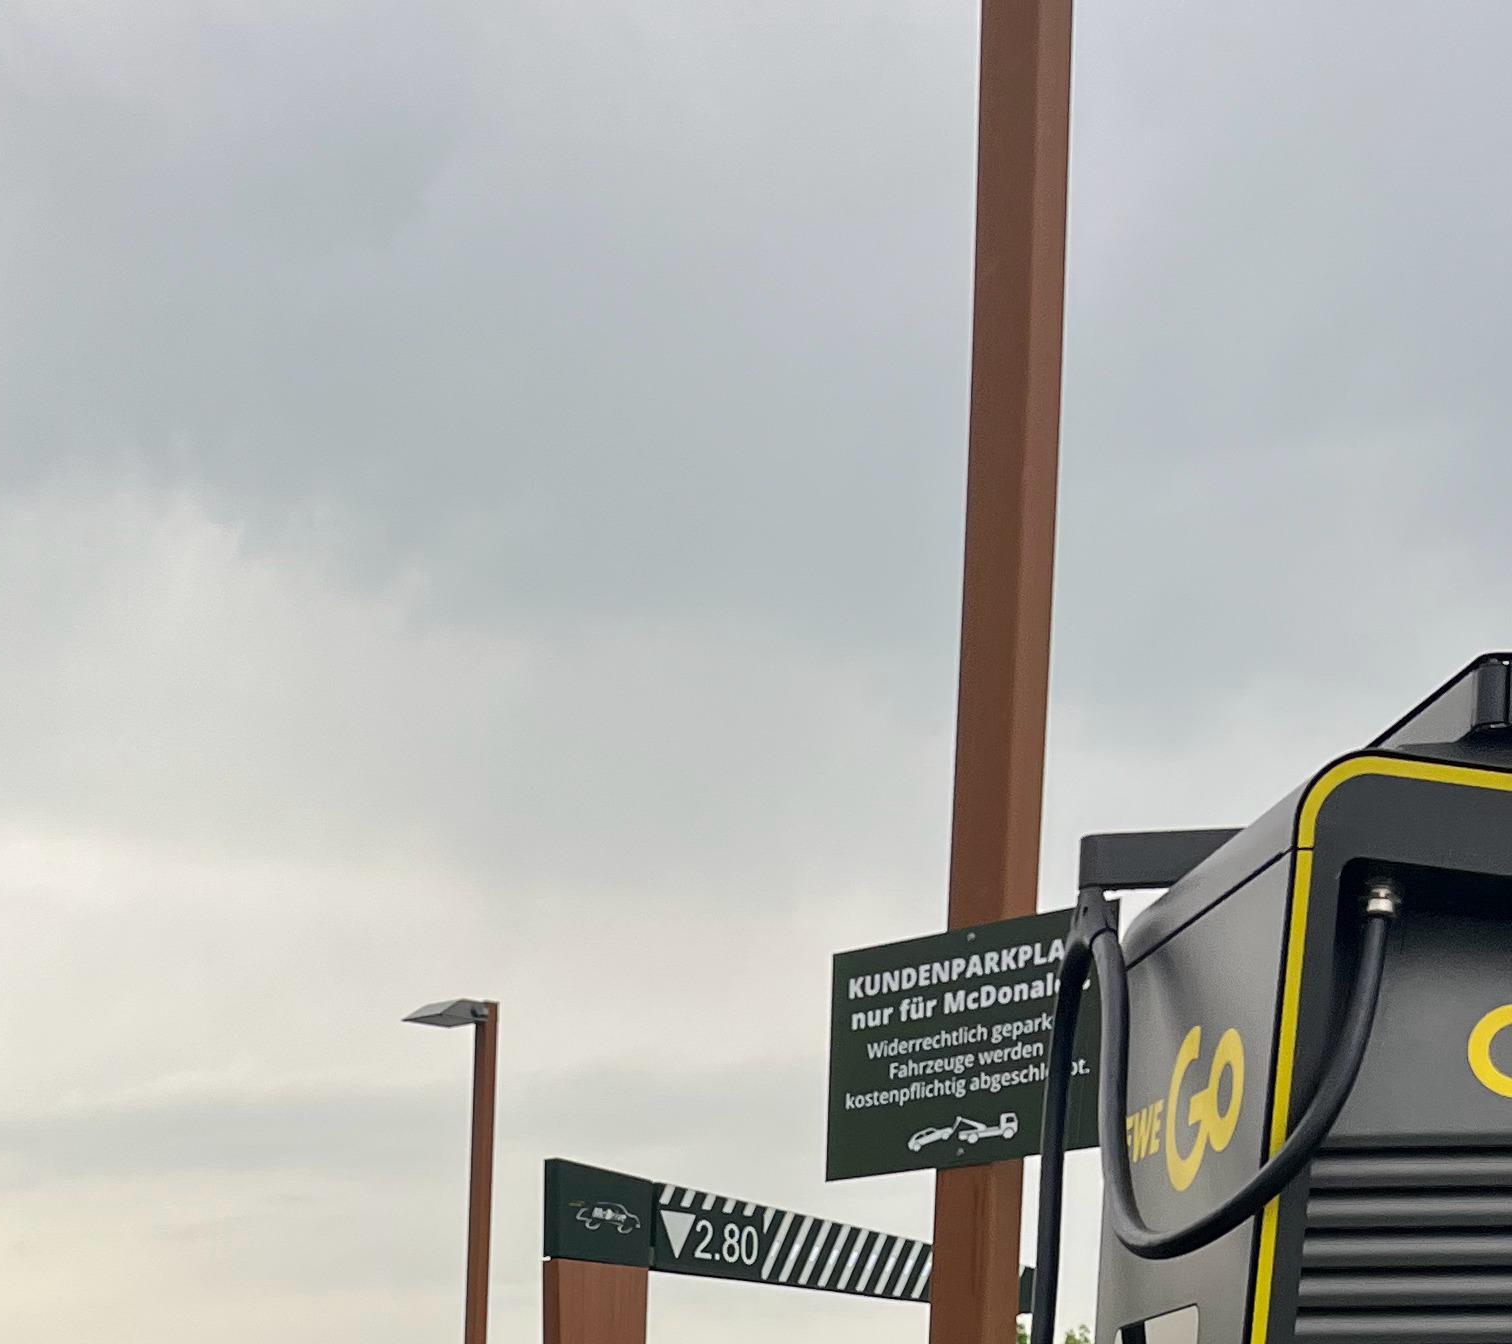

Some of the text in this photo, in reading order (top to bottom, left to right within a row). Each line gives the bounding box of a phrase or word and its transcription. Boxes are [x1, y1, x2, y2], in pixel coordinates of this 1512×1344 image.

[848, 938, 1066, 999] KUNDENPARKPLA
[851, 971, 1091, 1031] nur für McDonal
[867, 1012, 1055, 1060] Widerrechtlich gepark
[889, 1041, 1044, 1080] Fahrzeuge werden
[845, 1057, 1090, 1110] kostenpflichtig abgeschlt.
[1166, 1025, 1245, 1192] GO
[693, 1219, 759, 1266] 2.80
